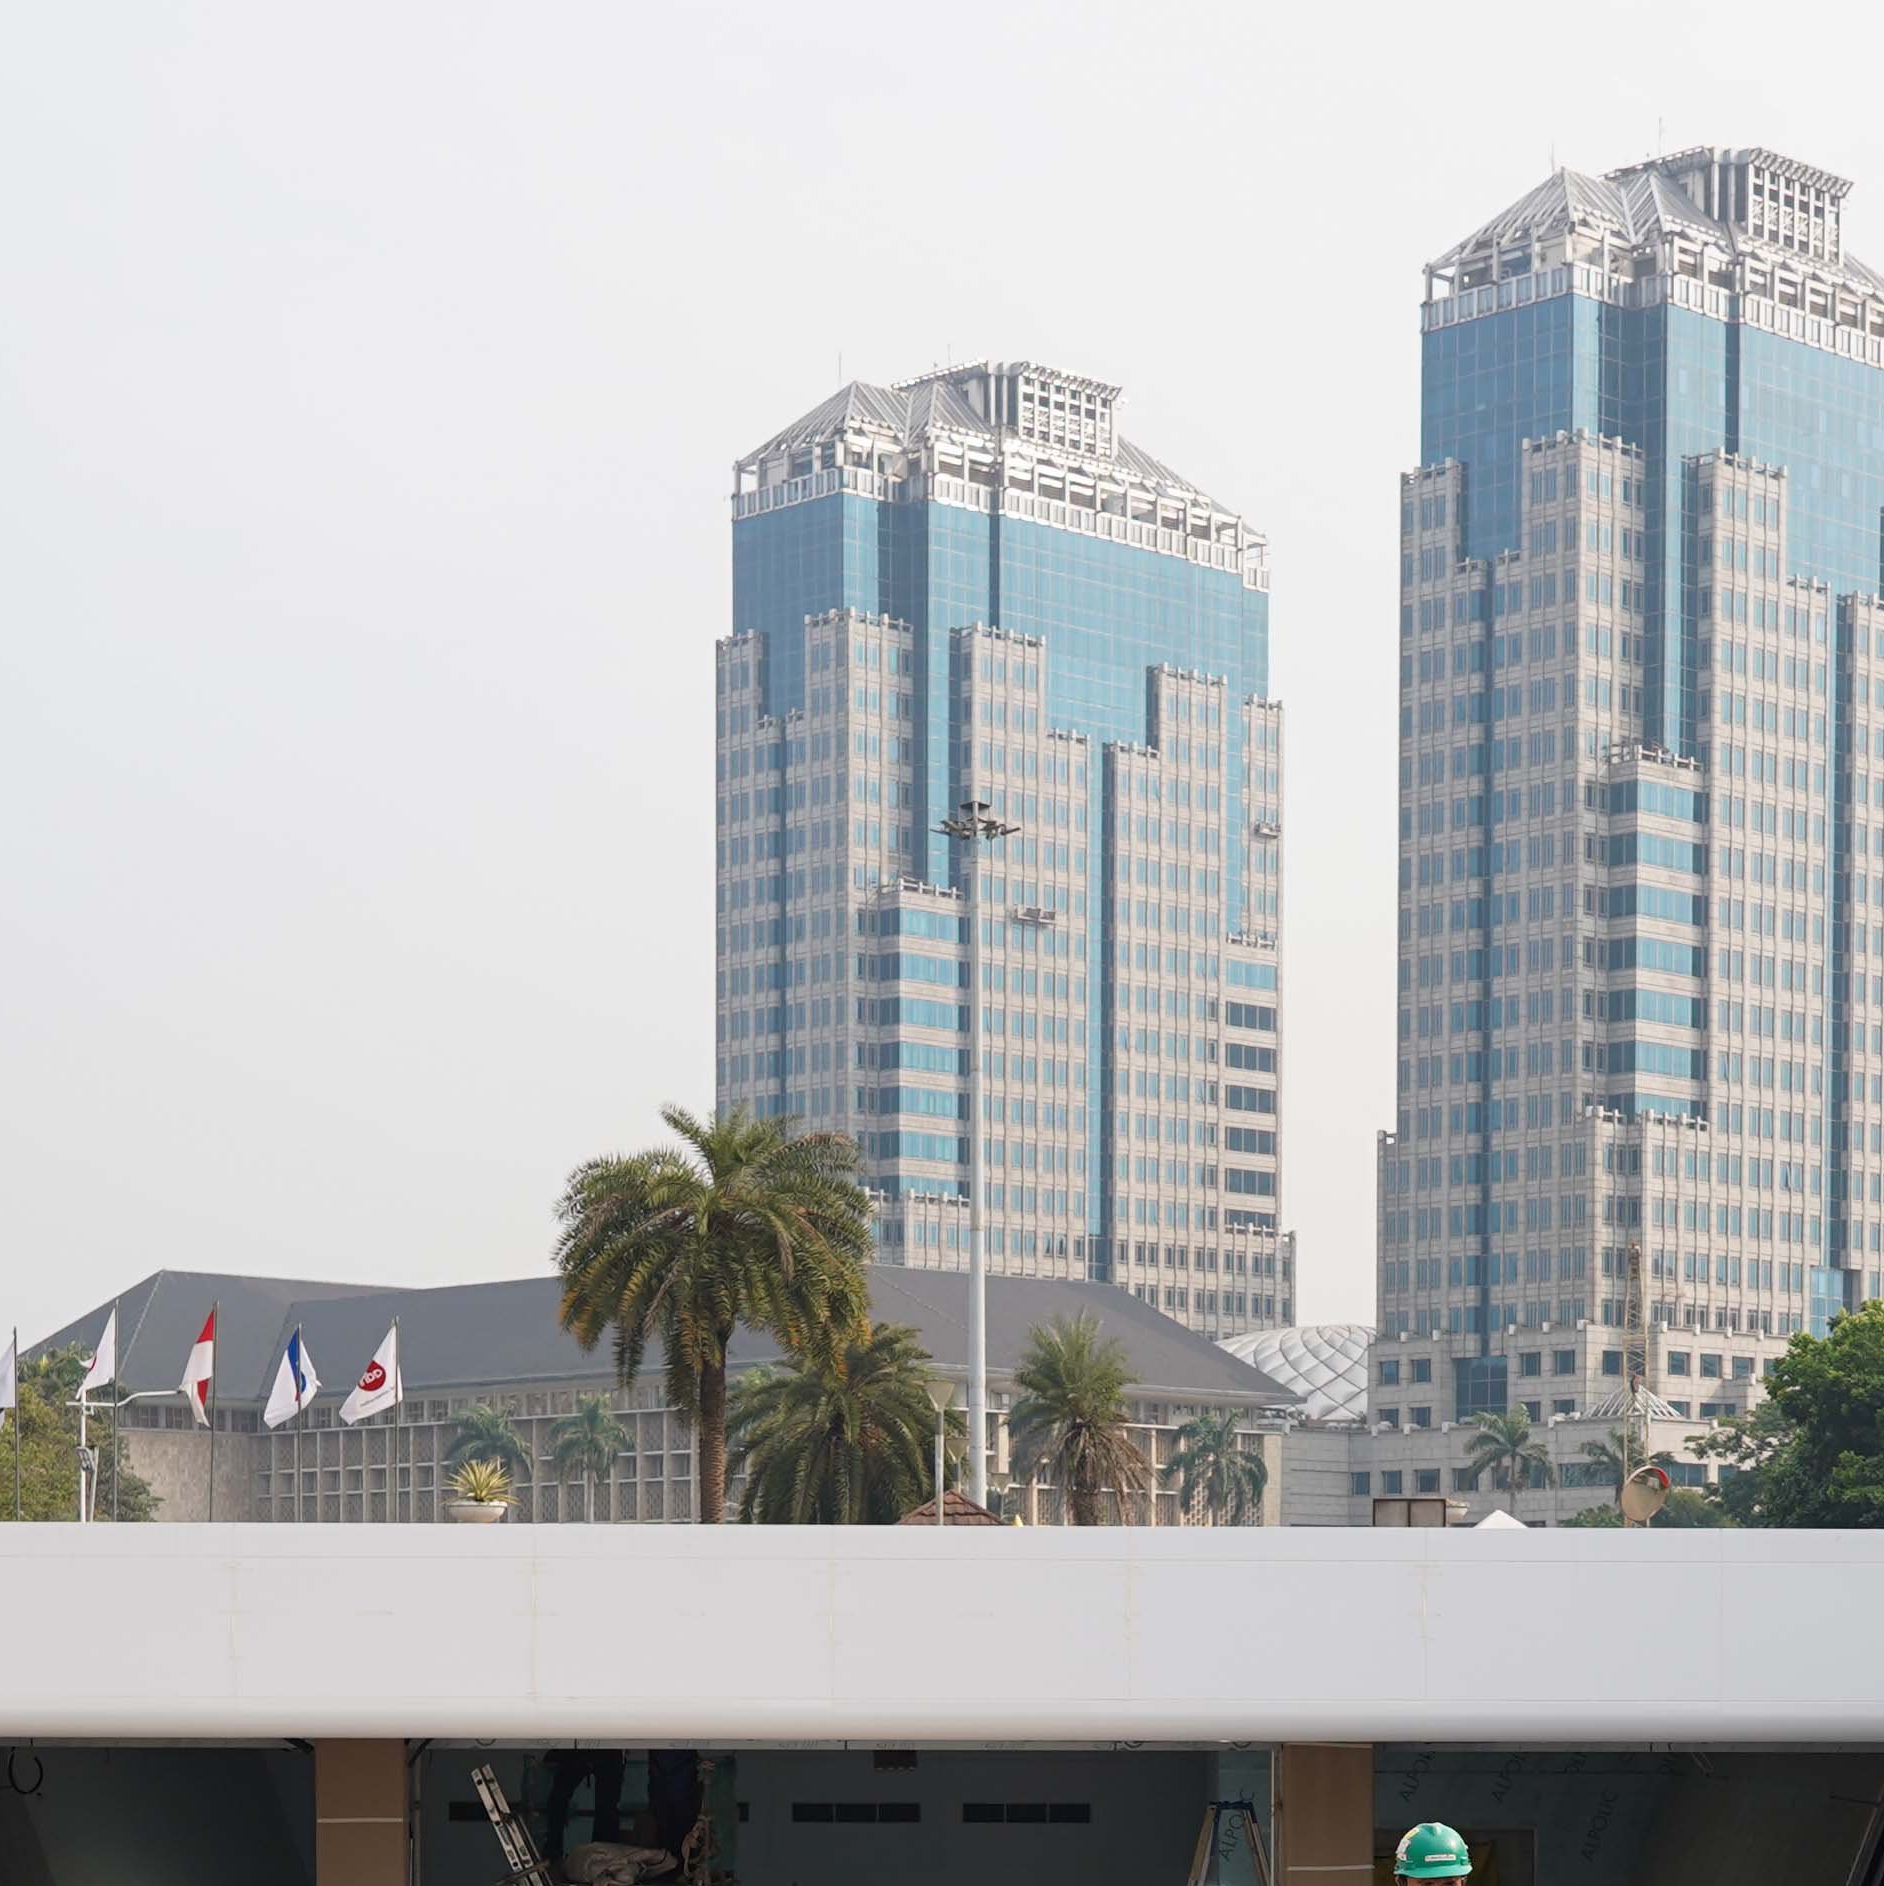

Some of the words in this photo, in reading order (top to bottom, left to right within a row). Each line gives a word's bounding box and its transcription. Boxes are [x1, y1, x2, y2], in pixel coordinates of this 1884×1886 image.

[1399, 1751, 1437, 1803] ALPOL
[1491, 1752, 1525, 1804] ALPOL
[1218, 1786, 1255, 1862] ALPOC
[1580, 1786, 1620, 1864] ALPOLIC
